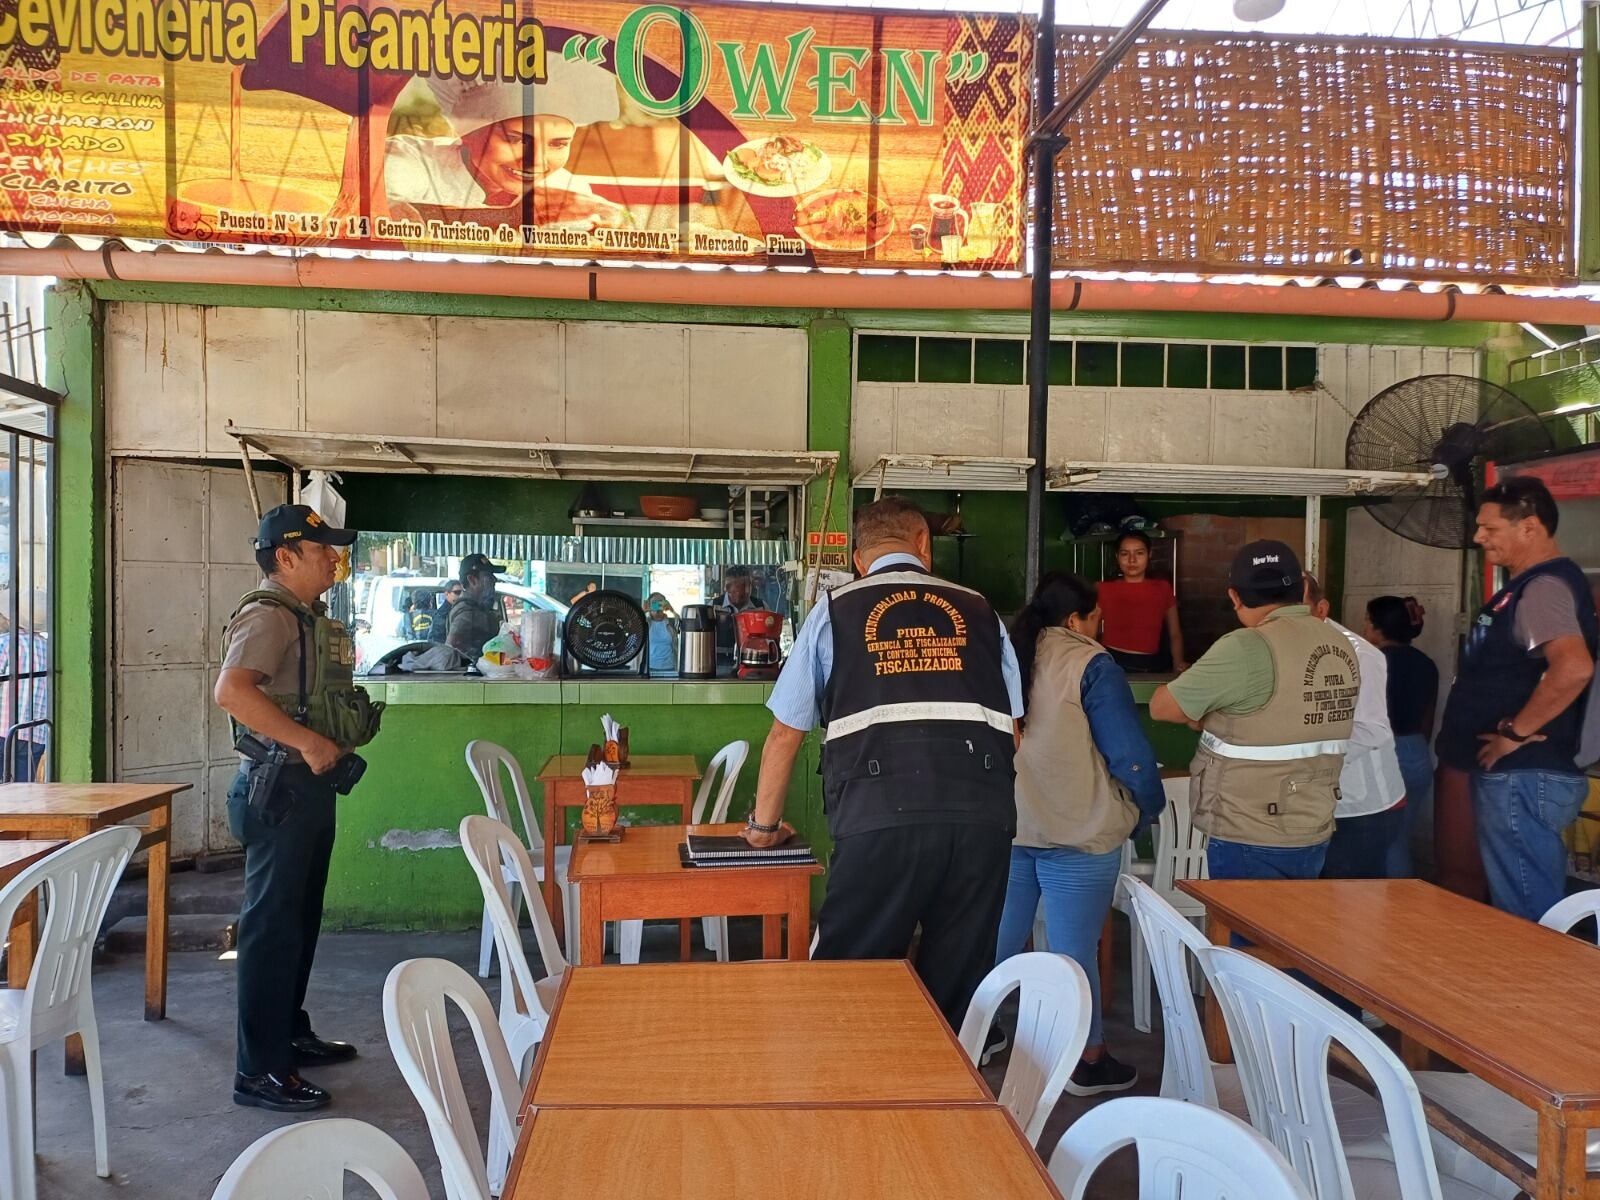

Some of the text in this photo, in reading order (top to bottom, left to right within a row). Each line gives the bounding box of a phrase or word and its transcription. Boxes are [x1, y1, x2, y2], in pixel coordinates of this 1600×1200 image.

[294, 0, 547, 81] Picanteria
[0, 67, 162, 87] ALDO DE PATA
[52, 90, 75, 103] DE
[81, 92, 163, 109] GALLINA
[7, 133, 124, 152] SUDADO
[0, 173, 132, 195] CLARITO
[29, 195, 111, 210] CHICHA
[23, 210, 116, 224] MORADA
[301, 215, 319, 232] 13
[330, 219, 338, 237] y
[350, 218, 367, 235] 14
[378, 220, 422, 238] Centro
[431, 223, 490, 241] Turistico
[499, 226, 514, 243] de
[523, 227, 588, 245] Vivandera
[694, 234, 748, 252] Mercado
[769, 237, 803, 254] Piura
[810, 533, 846, 545] DOS
[1252, 554, 1279, 566] New York
[865, 590, 966, 641] MUNICIPALIDAD PROVINCIAL
[896, 627, 936, 638] PIURA
[867, 640, 901, 652] GERENCIA
[904, 639, 913, 648] DE
[878, 647, 957, 660] Y CONTROL MUNICIPAL
[874, 657, 963, 676] FISCALIZADOR
[1324, 674, 1344, 686] PIURA
[1304, 713, 1323, 725] SUB
